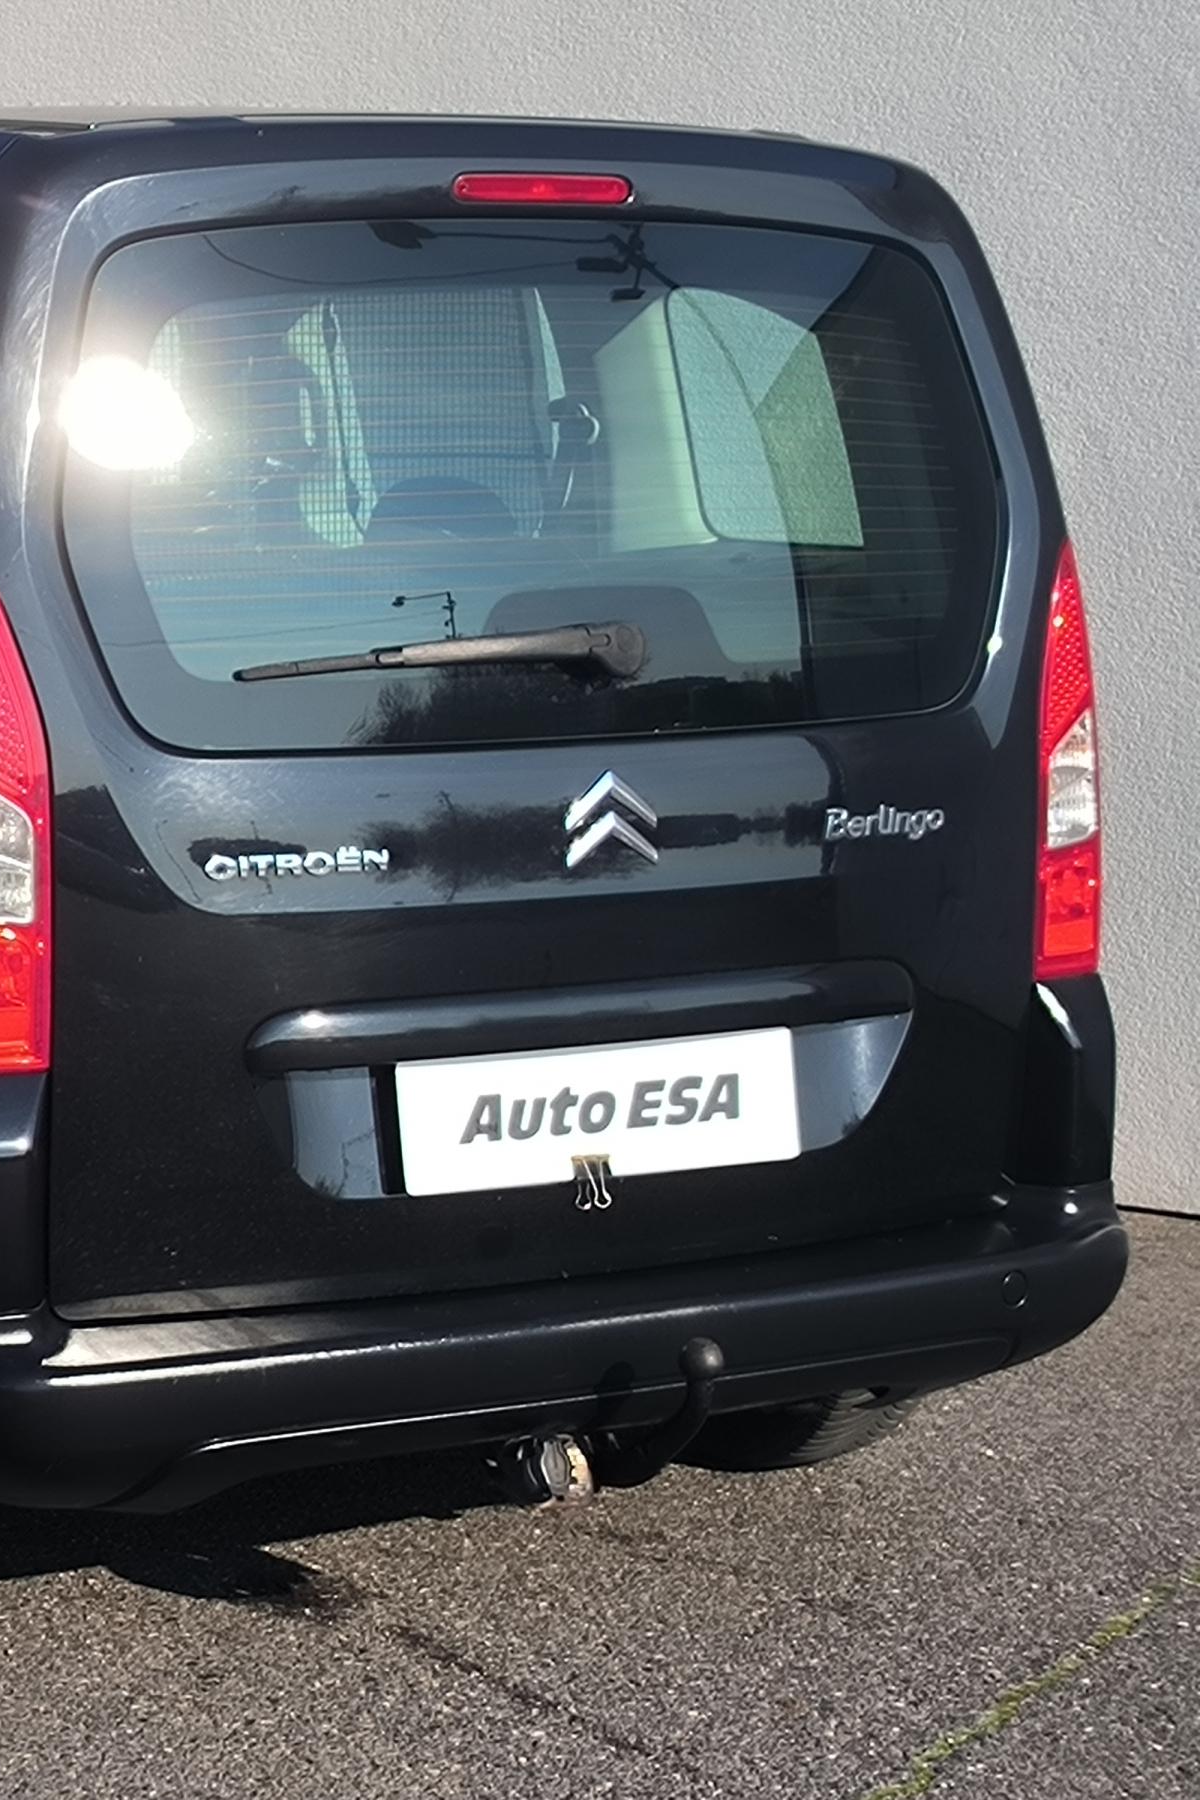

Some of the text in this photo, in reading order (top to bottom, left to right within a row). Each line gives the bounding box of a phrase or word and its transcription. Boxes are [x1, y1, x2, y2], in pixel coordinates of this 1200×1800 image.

[825, 804, 944, 839] Berlingo
[204, 846, 391, 880] CITROËN
[459, 1073, 740, 1144] Auto ESA
